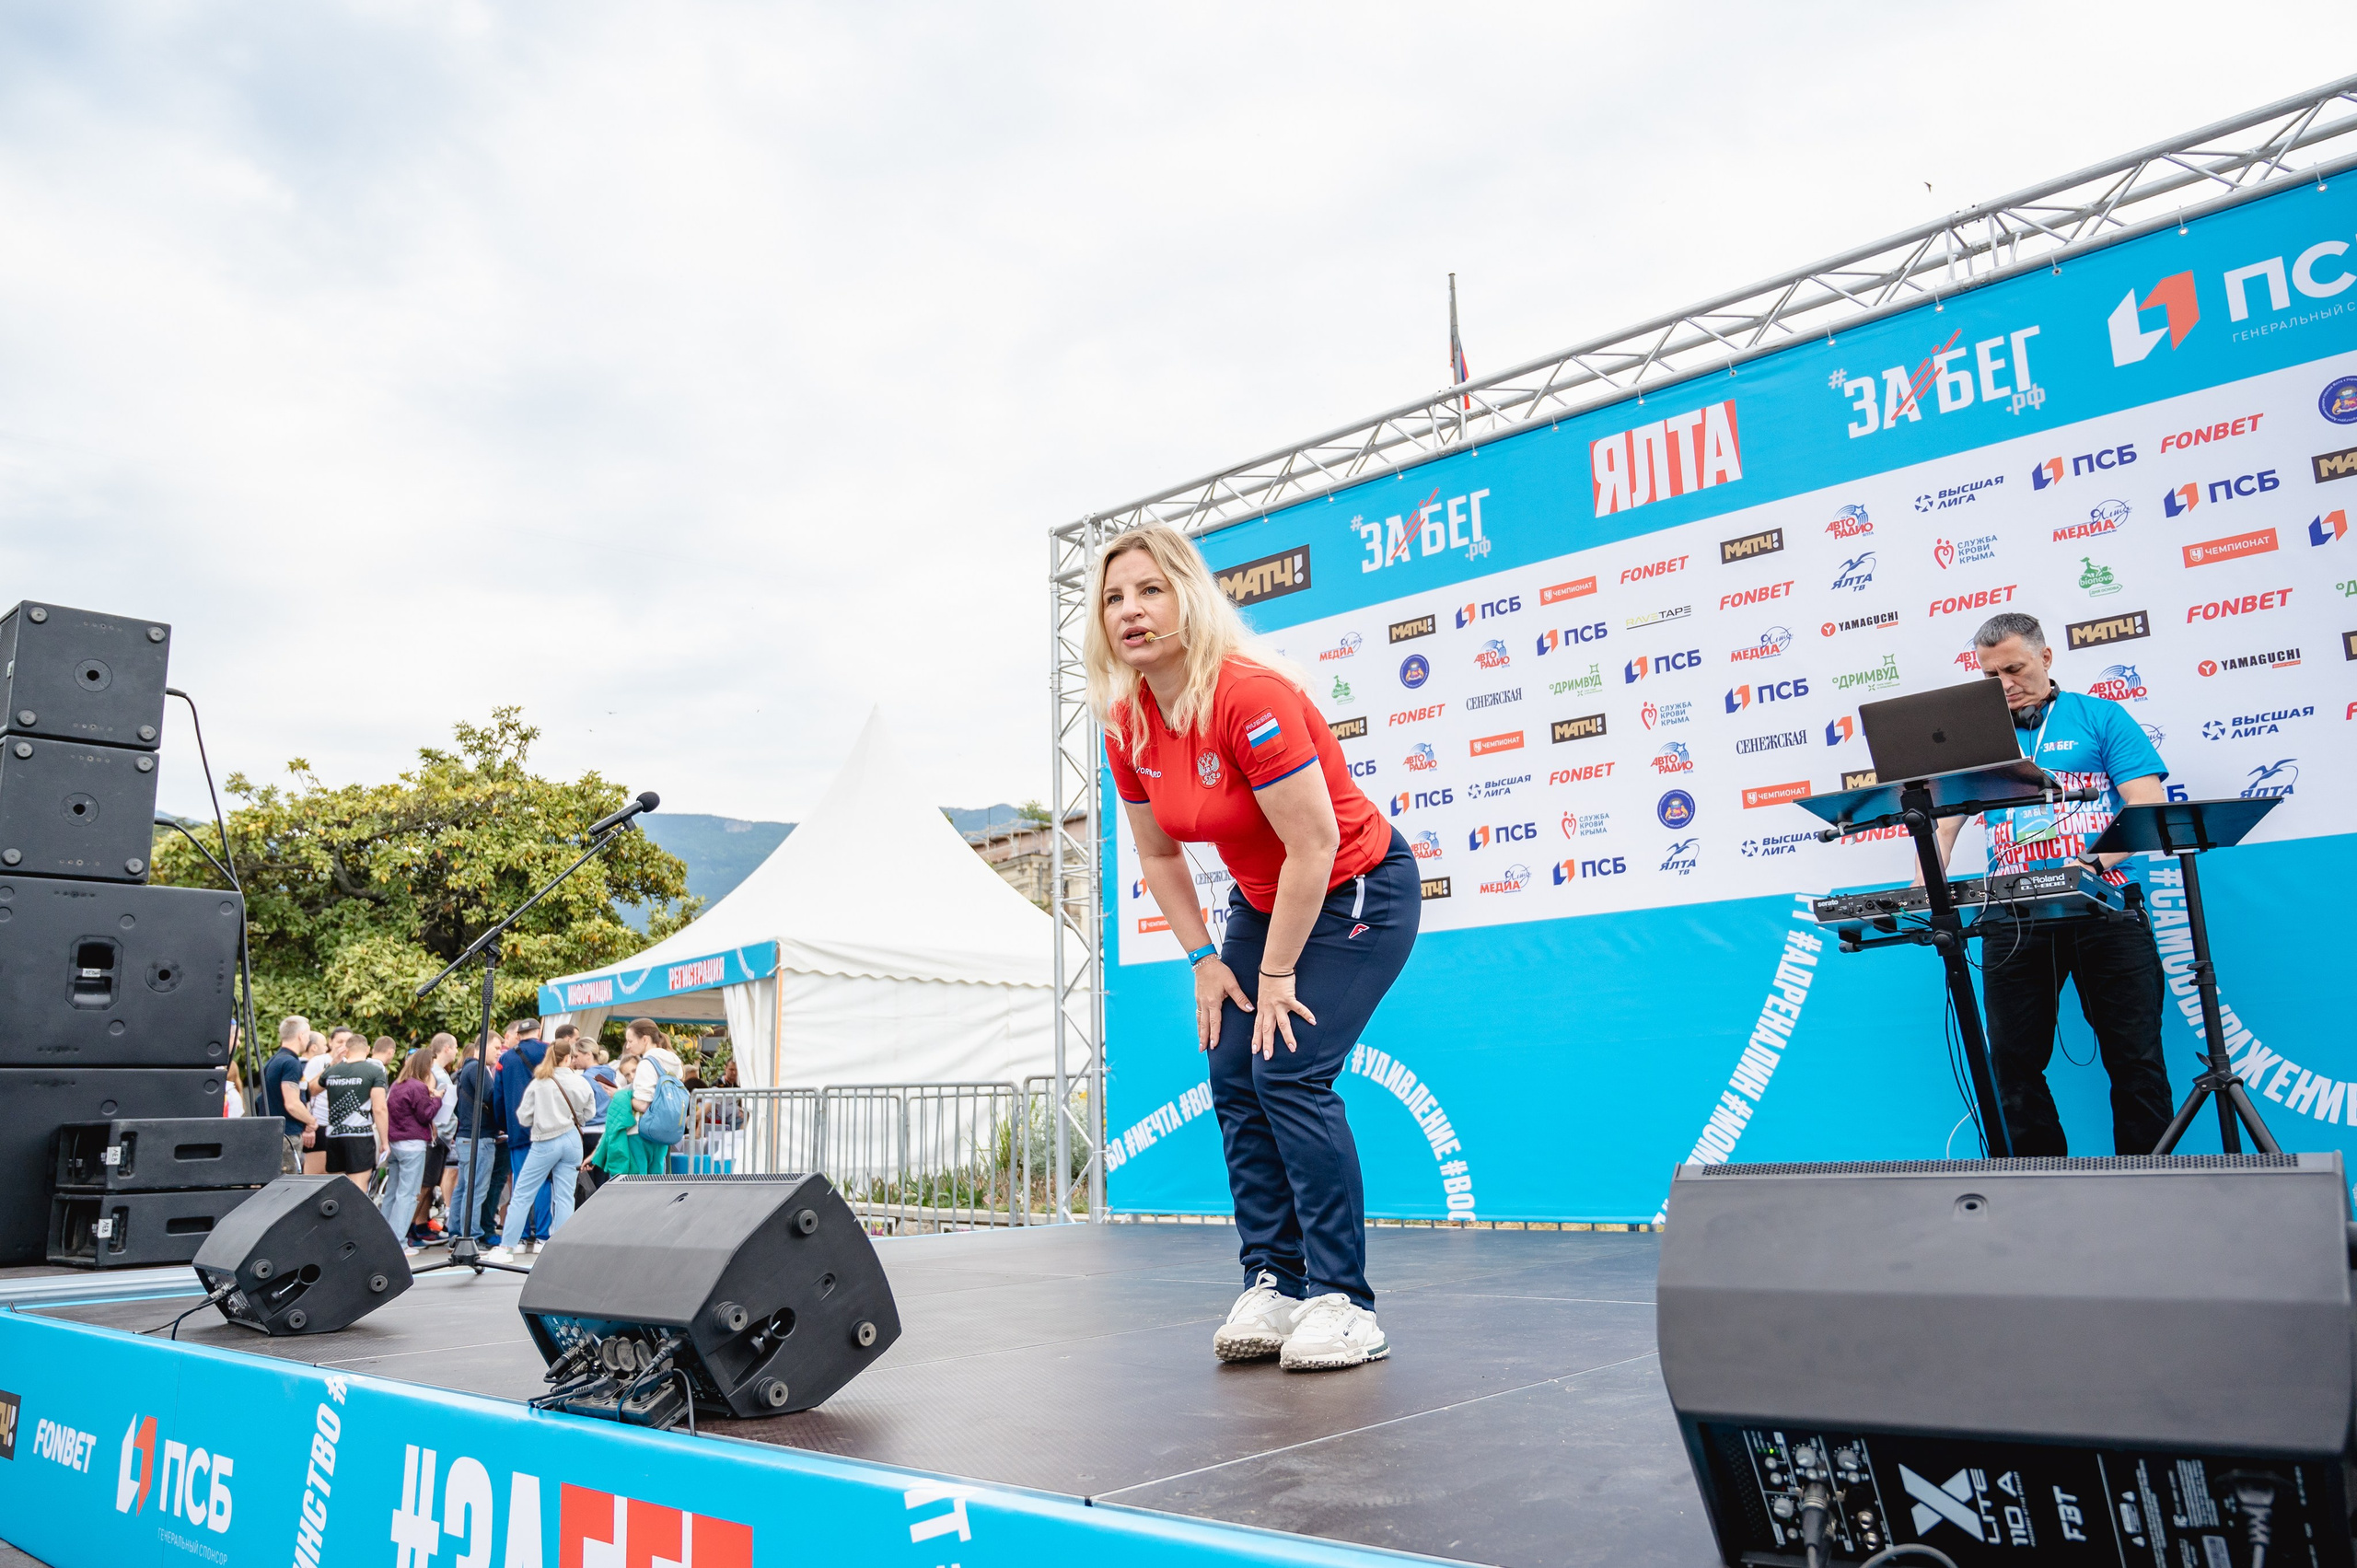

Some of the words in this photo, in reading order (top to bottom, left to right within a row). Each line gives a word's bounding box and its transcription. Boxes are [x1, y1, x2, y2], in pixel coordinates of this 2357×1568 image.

[2223, 234, 2357, 322] ПС
[2233, 302, 2344, 343] ГЕНЕРАЛЬНЫЙ
[2161, 412, 2264, 455] FONBET
[1592, 401, 1743, 517] ЯЛТА
[2073, 443, 2137, 477] ПСБ
[1938, 475, 2004, 499] ВЫСШАЯ
[2209, 469, 2280, 504] ПСБ
[1937, 494, 1976, 510] ЛИГА
[1825, 517, 1856, 534] АВТО
[1834, 522, 1874, 540] РАДИО
[2053, 518, 2117, 542] МЕДИА
[1724, 532, 1779, 560] МАТЧ!
[1957, 534, 1998, 550] СЛУЖБА
[1958, 543, 1991, 556] КРОВИ
[2205, 536, 2270, 556] ЧЕМПИОНАТ
[1959, 551, 1995, 564] КРЫМА
[1220, 553, 1304, 601] МАТЧ!
[1620, 555, 1689, 585] FONBET
[1553, 581, 1593, 598] ЧЕМПИОНАТ
[1831, 573, 1873, 590] ЯЛТА
[1852, 584, 1865, 592] ТВ
[2079, 575, 2114, 587] bionova
[1719, 580, 1794, 610] FONBET
[1929, 585, 2017, 618] FONBET
[1481, 596, 1522, 620] ПСБ
[2187, 588, 2293, 623] FONBET
[1626, 605, 1691, 627] RAVETAPE
[1839, 611, 1898, 632] YAMAGUCHI
[1391, 618, 1433, 642] МАТЧ!
[1564, 621, 1608, 646] ПСБ
[2072, 615, 2143, 645] МАТЧ!
[1319, 646, 1353, 662] МЕДИА
[1474, 650, 1497, 663] АВТО
[1480, 656, 1510, 669] РАДИО
[1655, 649, 1701, 674] ПСБ
[1731, 644, 1781, 662] МЕДИА
[1954, 650, 1976, 664] АВТ
[2221, 648, 2301, 670] YAMAGUCHI
[1554, 674, 1602, 696] ДРИМВУД
[1839, 666, 1899, 691] ДРИМВУД
[2087, 679, 2124, 695] АВТО
[1466, 688, 1522, 711] СЕНЕЖСКАЯ
[1758, 678, 1808, 704] ПСБ
[1388, 703, 1446, 726] FONBET
[1660, 701, 1692, 713] СЛУЖБА
[1660, 709, 1686, 719] КРОВИ
[2232, 706, 2314, 726] ВЫСШАЯ
[1246, 712, 1271, 731] RUSSIA
[1555, 717, 1603, 740] МАТЧ!
[1661, 715, 1689, 726] КРЫМА
[1736, 729, 1807, 754] СЕНЕЖСКАЯ
[2231, 724, 2279, 739] ЛИГА
[1481, 737, 1520, 749] ЧЕМПИОНАТ
[1403, 753, 1424, 765] АВТО
[1410, 759, 1437, 772] РАДИО
[1650, 754, 1678, 768] АВТО
[1658, 761, 1693, 774] РАДИО
[1485, 774, 1531, 789] ВЫСШАЯ
[1550, 761, 1615, 785] FONBET
[1415, 788, 1454, 808] ПСБ
[1483, 787, 1511, 798] ЛИГА
[1758, 786, 1805, 800] ЧЕМПИОНАТ
[1579, 812, 1609, 823] СЛУЖБА
[1579, 819, 1604, 830] КРОВИ
[1495, 822, 1537, 843] ПСБ
[1580, 827, 1607, 836] КРЫМА
[1762, 831, 1818, 846] ВЫСШАЯ
[1841, 824, 1910, 844] FONBE
[1414, 848, 1443, 859] РАДИО
[1762, 845, 1796, 856] ЛИГА
[1582, 856, 1626, 877] ПСБ
[1659, 859, 1696, 871] ЯЛТА
[1195, 869, 1235, 885] СЕНЕЖСК
[1480, 880, 1520, 894] МЕДИА
[2033, 873, 2065, 884] Roland
[1817, 899, 1839, 907] serato
[668, 957, 725, 991] РЕГИСТРАЦИЯ
[567, 979, 613, 1006] ИНФОРМАЦИЯ
[1728, 930, 1823, 1102] #АДРЕНАЛИН
[326, 1077, 363, 1086] FINISHER
[1351, 1043, 1462, 1161] #УДИВЛЕНИЕ
[1123, 1100, 1183, 1158] #МЕЧТА
[1179, 1078, 1213, 1123] #ВО
[1685, 1090, 1754, 1166] #МОМ
[32, 1418, 97, 1474] FONBET
[159, 1439, 234, 1534] ПСБ
[2052, 1485, 2086, 1541] FBT
[157, 1527, 199, 1555] ГЕНЕРАЛЬНЫЙ
[199, 1540, 228, 1567] СПОНСОР
